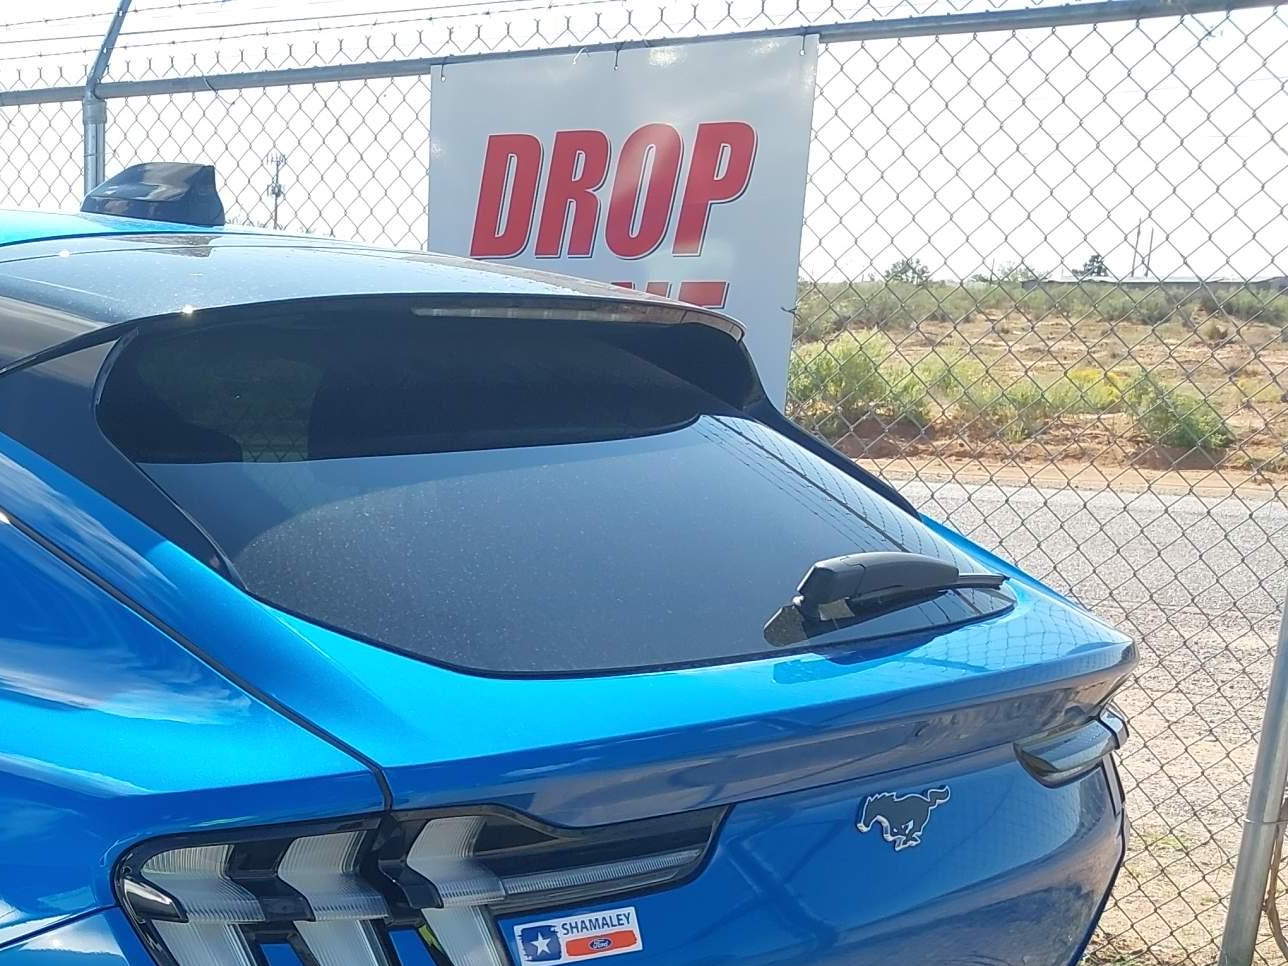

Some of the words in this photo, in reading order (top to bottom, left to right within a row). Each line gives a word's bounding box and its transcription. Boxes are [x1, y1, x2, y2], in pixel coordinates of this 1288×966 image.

[469, 121, 759, 260] DROP
[561, 912, 631, 936] SHAMALEY
[592, 938, 611, 950] Ford
